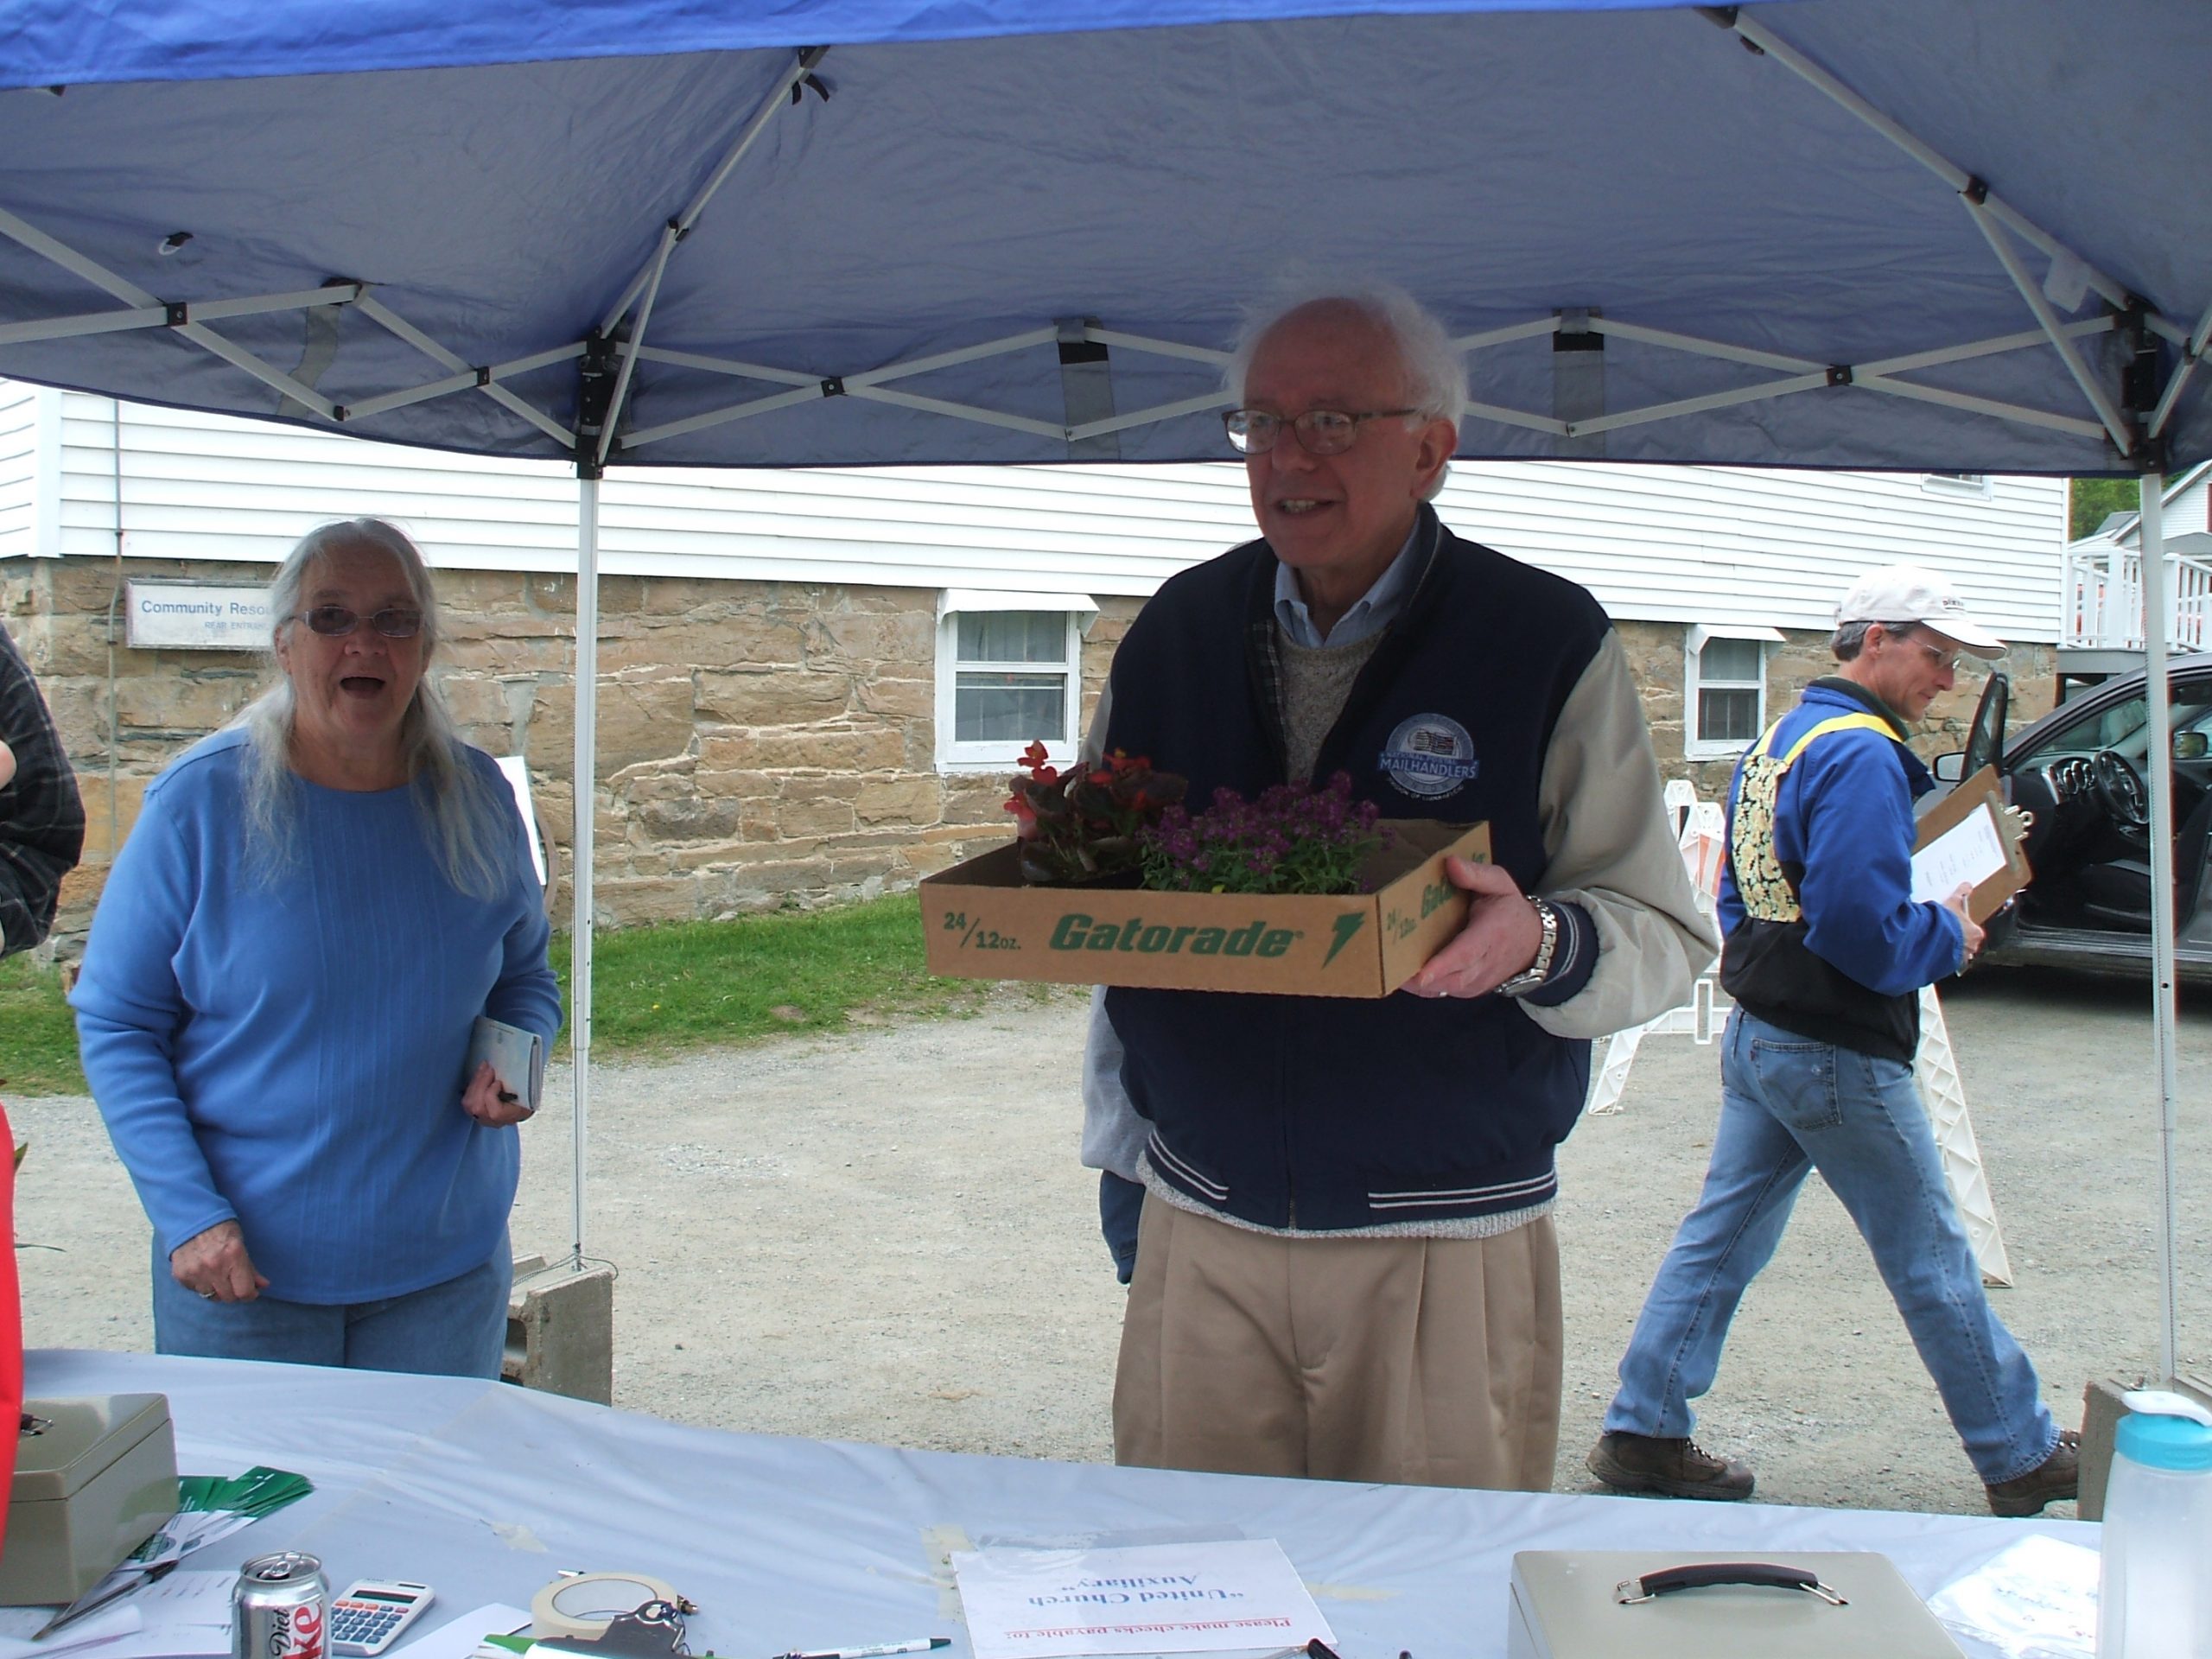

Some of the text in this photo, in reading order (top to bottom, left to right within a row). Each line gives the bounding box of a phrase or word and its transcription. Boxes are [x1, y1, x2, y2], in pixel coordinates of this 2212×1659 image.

[142, 601, 222, 616] Community
[1380, 759, 1476, 779] MAILHANDLERS
[1048, 912, 1294, 958] Gatorade
[1028, 1592, 1130, 1606] Church
[269, 1608, 291, 1656] Diet
[283, 1603, 322, 1659] ke
[1007, 1618, 1292, 1640] Please make checks payable to:
